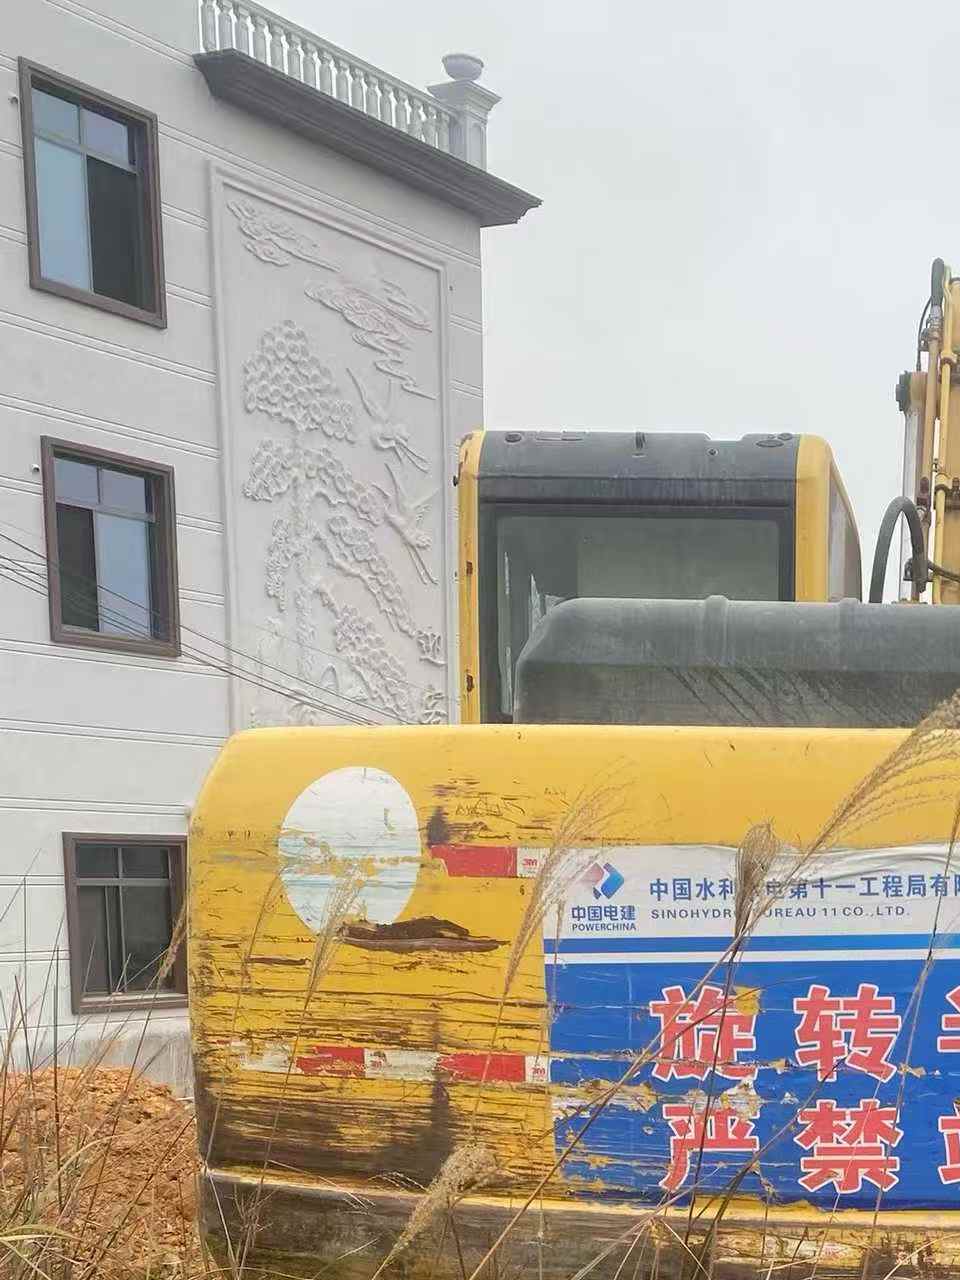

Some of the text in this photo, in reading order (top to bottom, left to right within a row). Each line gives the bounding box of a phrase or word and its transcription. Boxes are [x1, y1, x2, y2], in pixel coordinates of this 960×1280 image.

[571, 904, 636, 921] 中国电建
[651, 908, 738, 920] SINOHYDR
[572, 922, 637, 932] POWERCHINA
